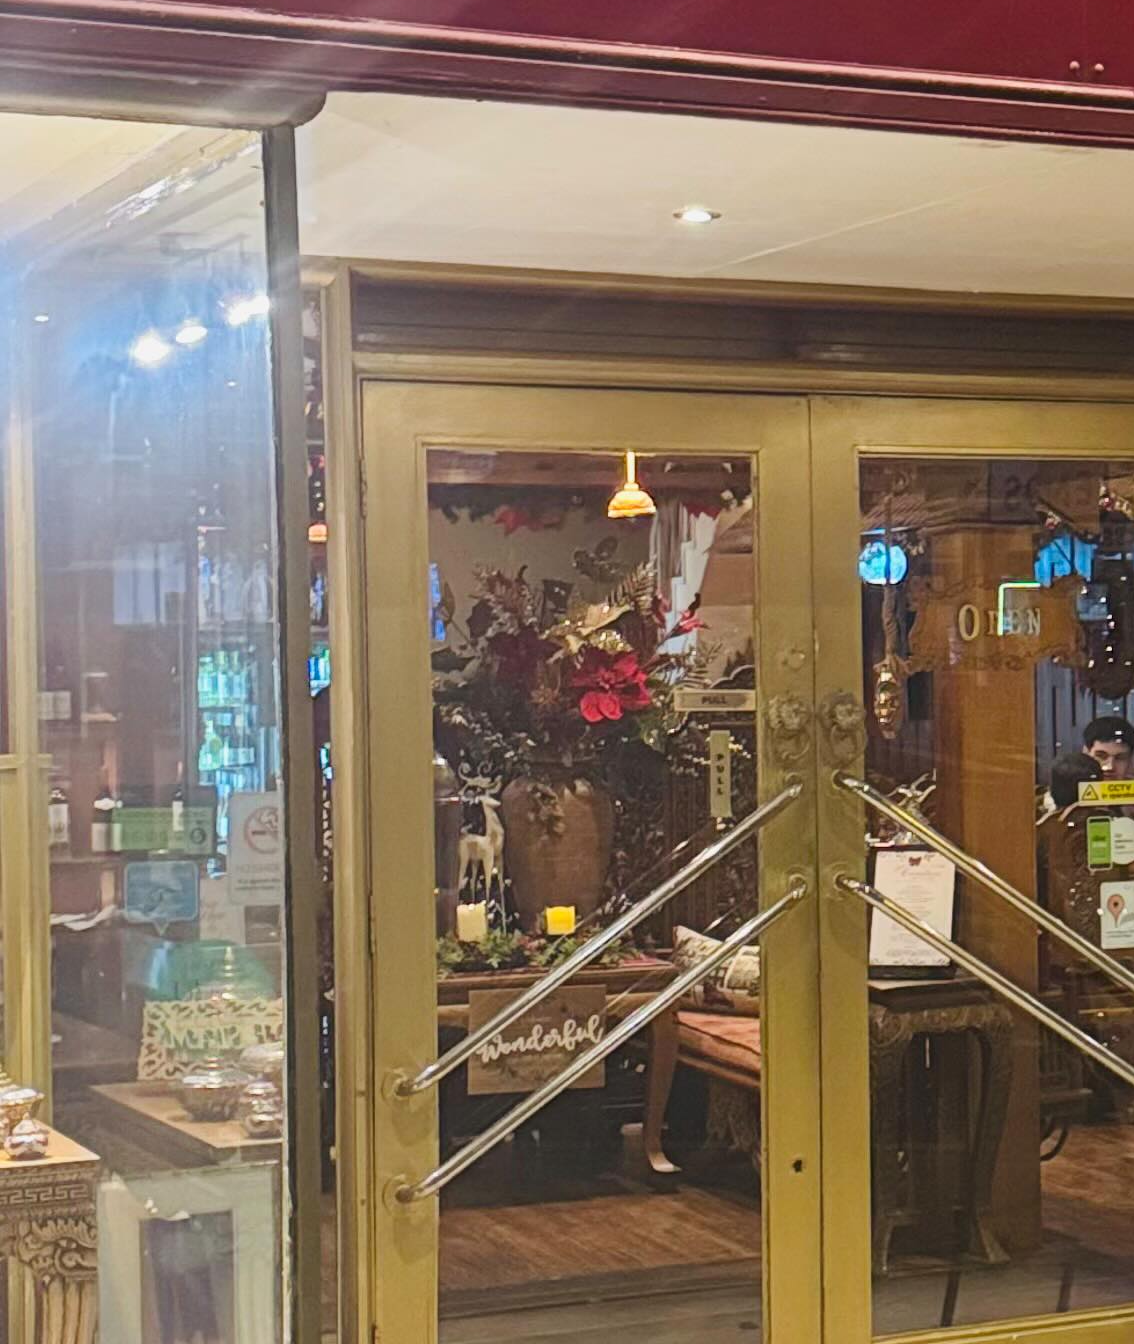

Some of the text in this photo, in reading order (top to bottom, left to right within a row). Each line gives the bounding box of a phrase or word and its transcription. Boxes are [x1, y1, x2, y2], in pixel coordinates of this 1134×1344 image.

[716, 752, 725, 795] PULL
[1107, 783, 1133, 793] CCTV
[475, 1013, 605, 1064] Wonderful
